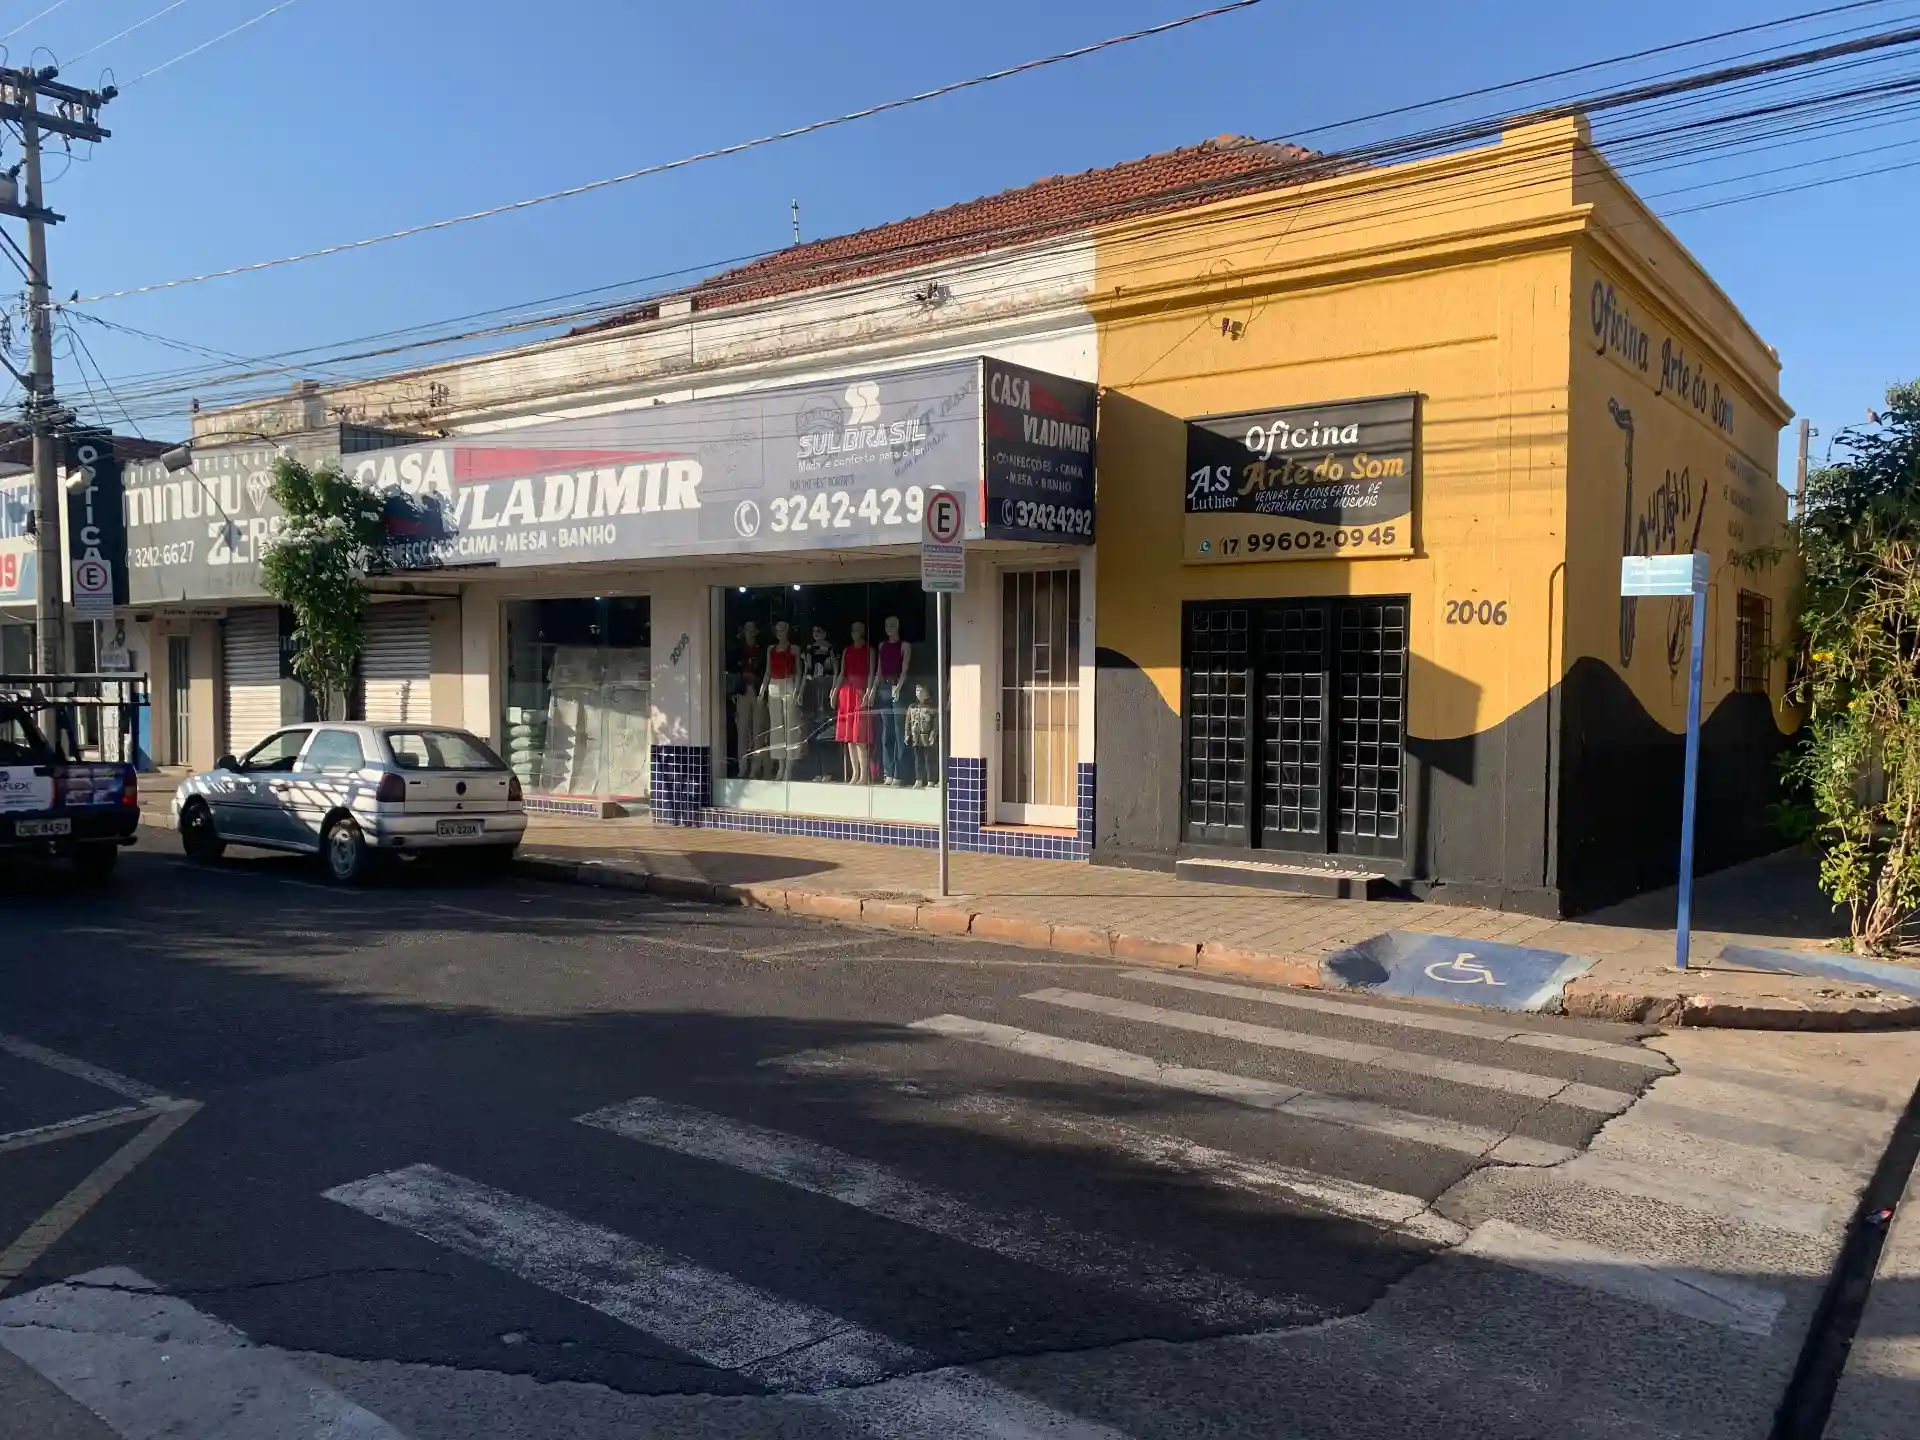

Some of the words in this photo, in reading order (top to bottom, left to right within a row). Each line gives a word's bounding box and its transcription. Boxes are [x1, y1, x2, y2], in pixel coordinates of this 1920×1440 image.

[1591, 280, 1649, 373] Oficina
[1655, 337, 1690, 397] Arte
[1693, 363, 1706, 414] do
[1712, 383, 1734, 435] Som
[990, 372, 1031, 410] CASA
[797, 431, 841, 459] SUL
[843, 419, 926, 451] BRASIL
[1022, 414, 1091, 453] VLADIMIR
[1245, 420, 1359, 461] Oficina
[357, 449, 452, 495] CASA
[1009, 471, 1033, 487] MESA
[1060, 463, 1084, 478] CAMA
[1313, 451, 1344, 483] do
[1350, 452, 1405, 480] Som
[1192, 495, 1239, 511] Luthier
[1255, 489, 1289, 502] VENDAS
[1293, 488, 1300, 499] E
[1303, 483, 1360, 499] CONSERTOS
[1368, 481, 1383, 495] DE
[1255, 498, 1327, 513] INSTRUMENTOS
[1332, 494, 1379, 509] MUSICAIS
[938, 503, 950, 532] E
[459, 534, 498, 556] CAMA
[505, 529, 547, 551] MESA
[558, 523, 616, 548] BANHO
[86, 567, 98, 586] E
